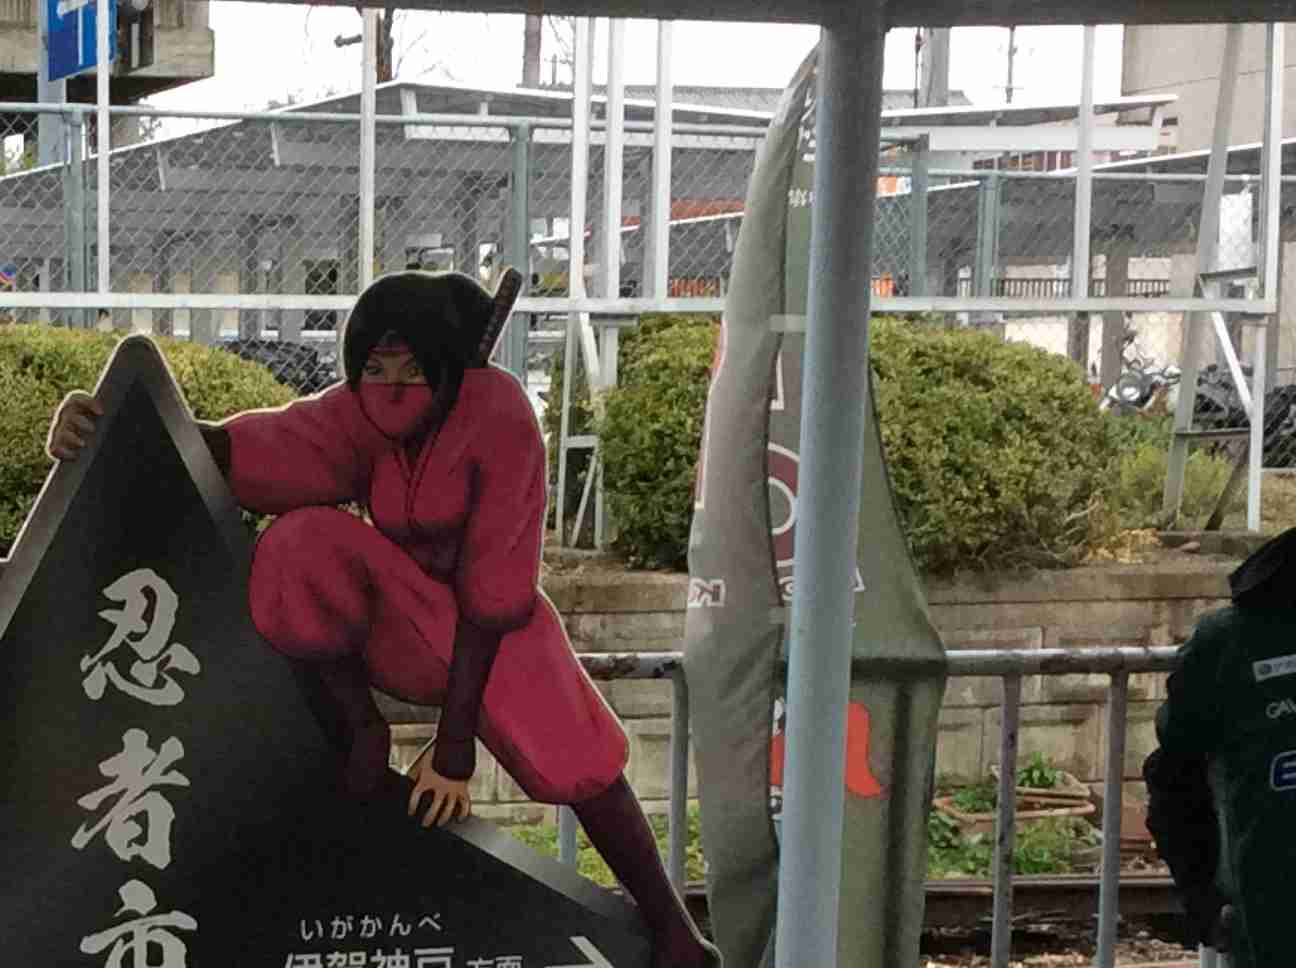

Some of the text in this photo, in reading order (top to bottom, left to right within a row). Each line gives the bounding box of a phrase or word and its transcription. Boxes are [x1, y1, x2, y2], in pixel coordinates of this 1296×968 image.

[300, 913, 442, 941] いがかんべ
